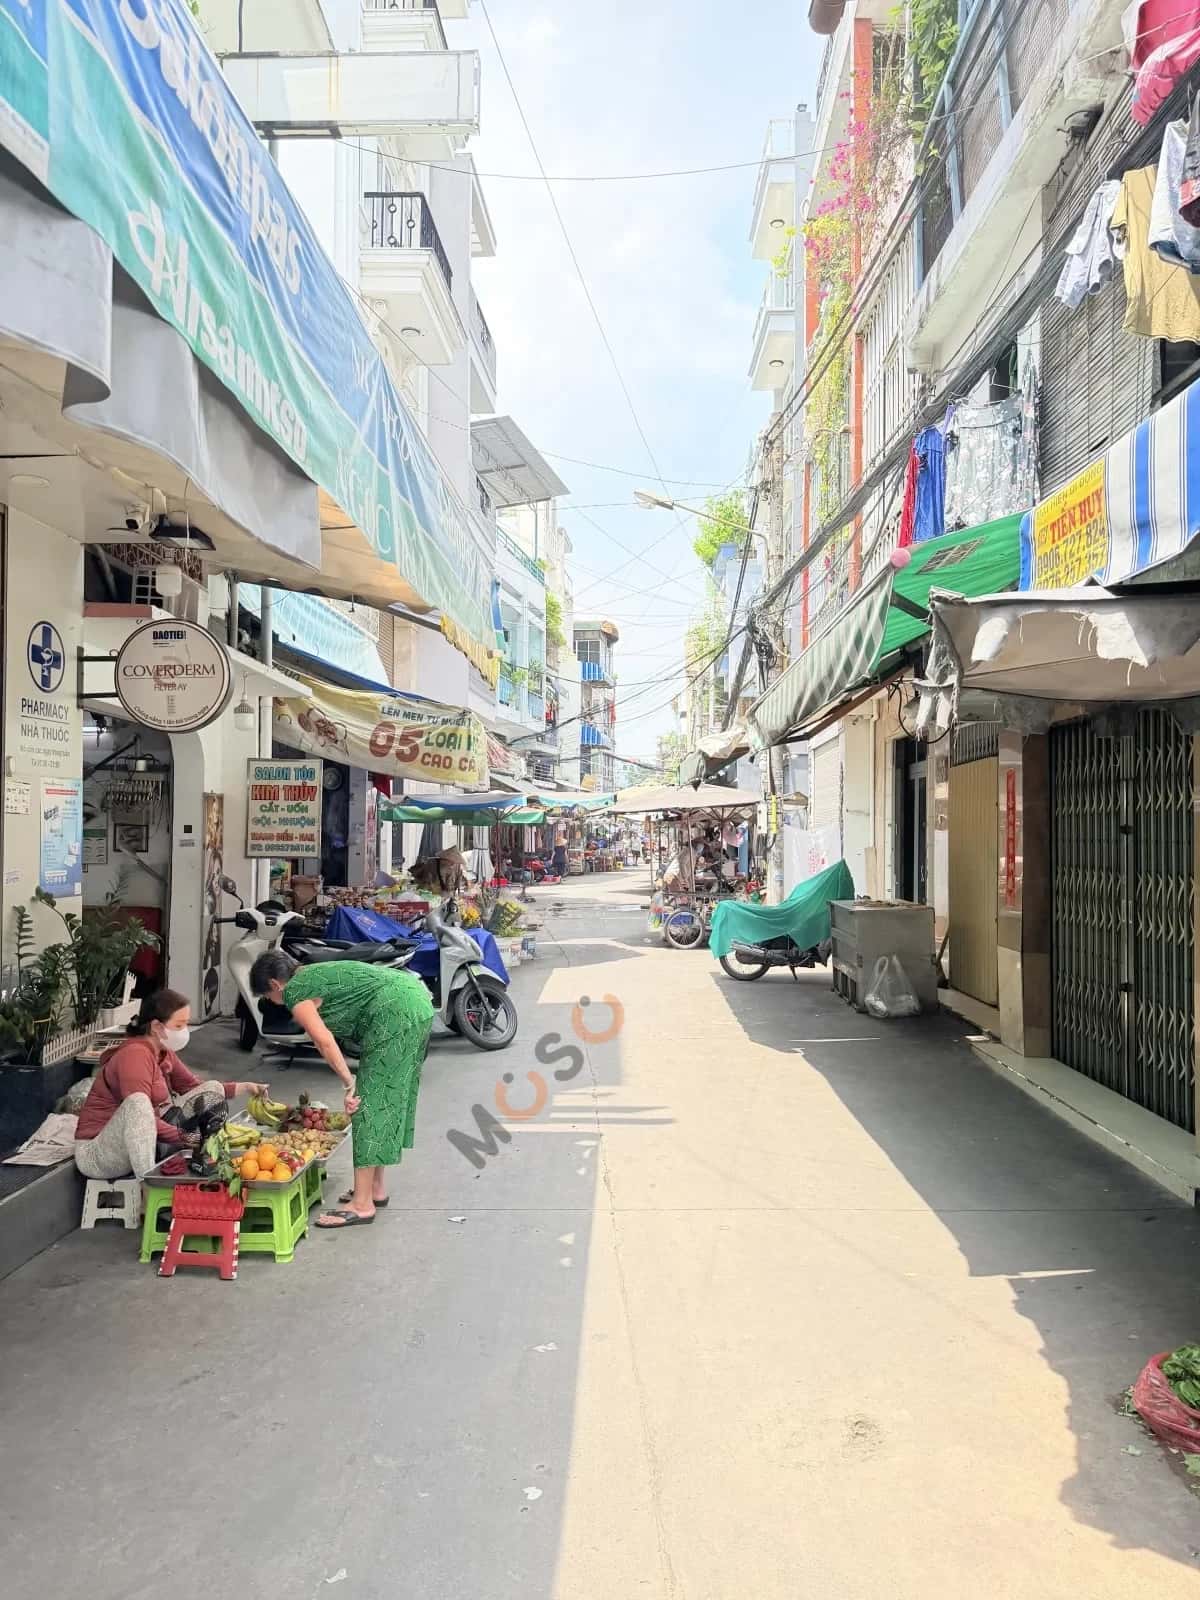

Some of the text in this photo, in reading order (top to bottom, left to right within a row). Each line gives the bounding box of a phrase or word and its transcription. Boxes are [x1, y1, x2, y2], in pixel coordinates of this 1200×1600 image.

[1079, 488, 1104, 525] HUY
[122, 663, 217, 679] COVERDERM
[21, 697, 70, 721] PHARMACY
[402, 710, 424, 721] MEN
[20, 721, 71, 742] NHÀ THUỐC
[370, 720, 424, 763] 05
[420, 752, 453, 770] CAO
[254, 766, 291, 781] SALON
[251, 784, 280, 801] KIM
